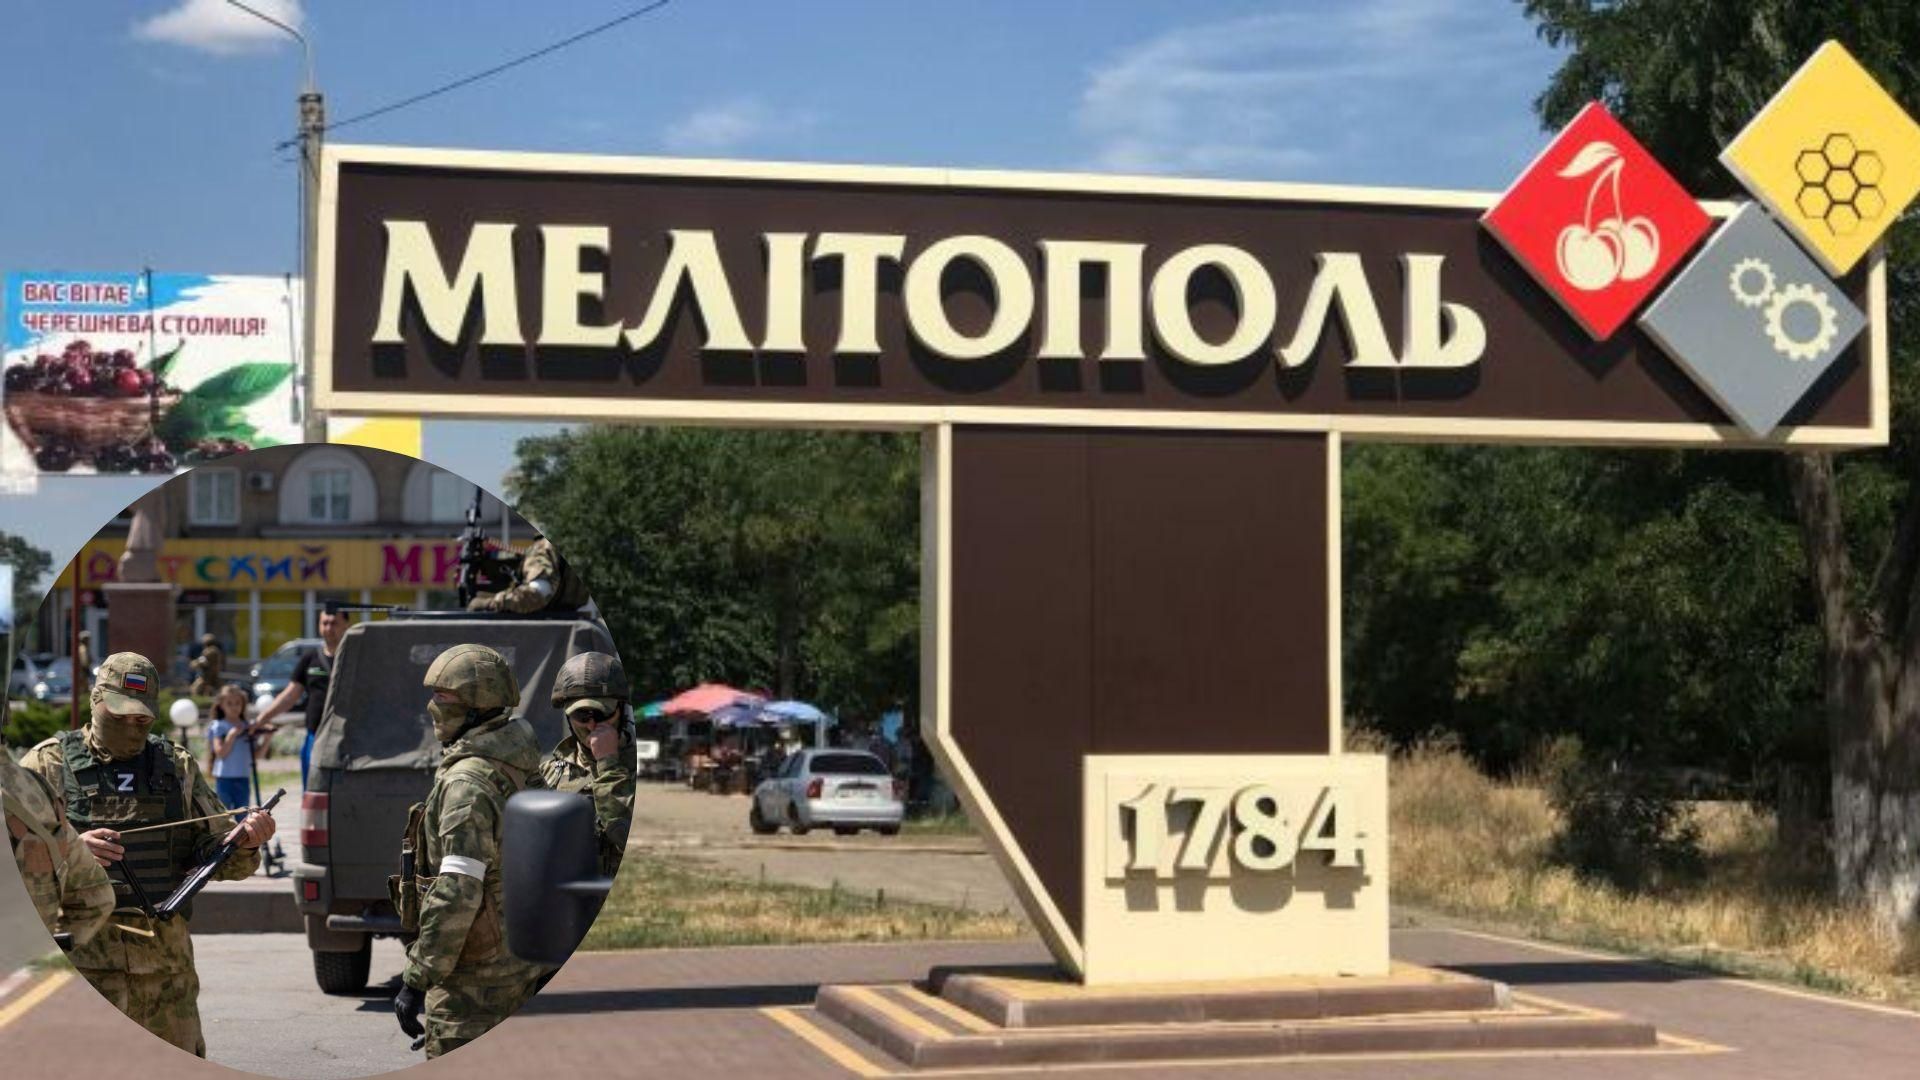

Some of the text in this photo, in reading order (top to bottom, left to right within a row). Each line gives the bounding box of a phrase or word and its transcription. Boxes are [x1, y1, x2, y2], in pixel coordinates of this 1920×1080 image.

[24, 283, 67, 301] ВАС
[371, 219, 1487, 369] МЕЛІТОПОЛЬ
[23, 313, 267, 337] ЧЕРЕШНЕВА СТОЛИЦЯ!
[86, 546, 330, 584] ДТСКИЙ
[117, 773, 135, 791] Z
[1118, 784, 1366, 871] 1784
